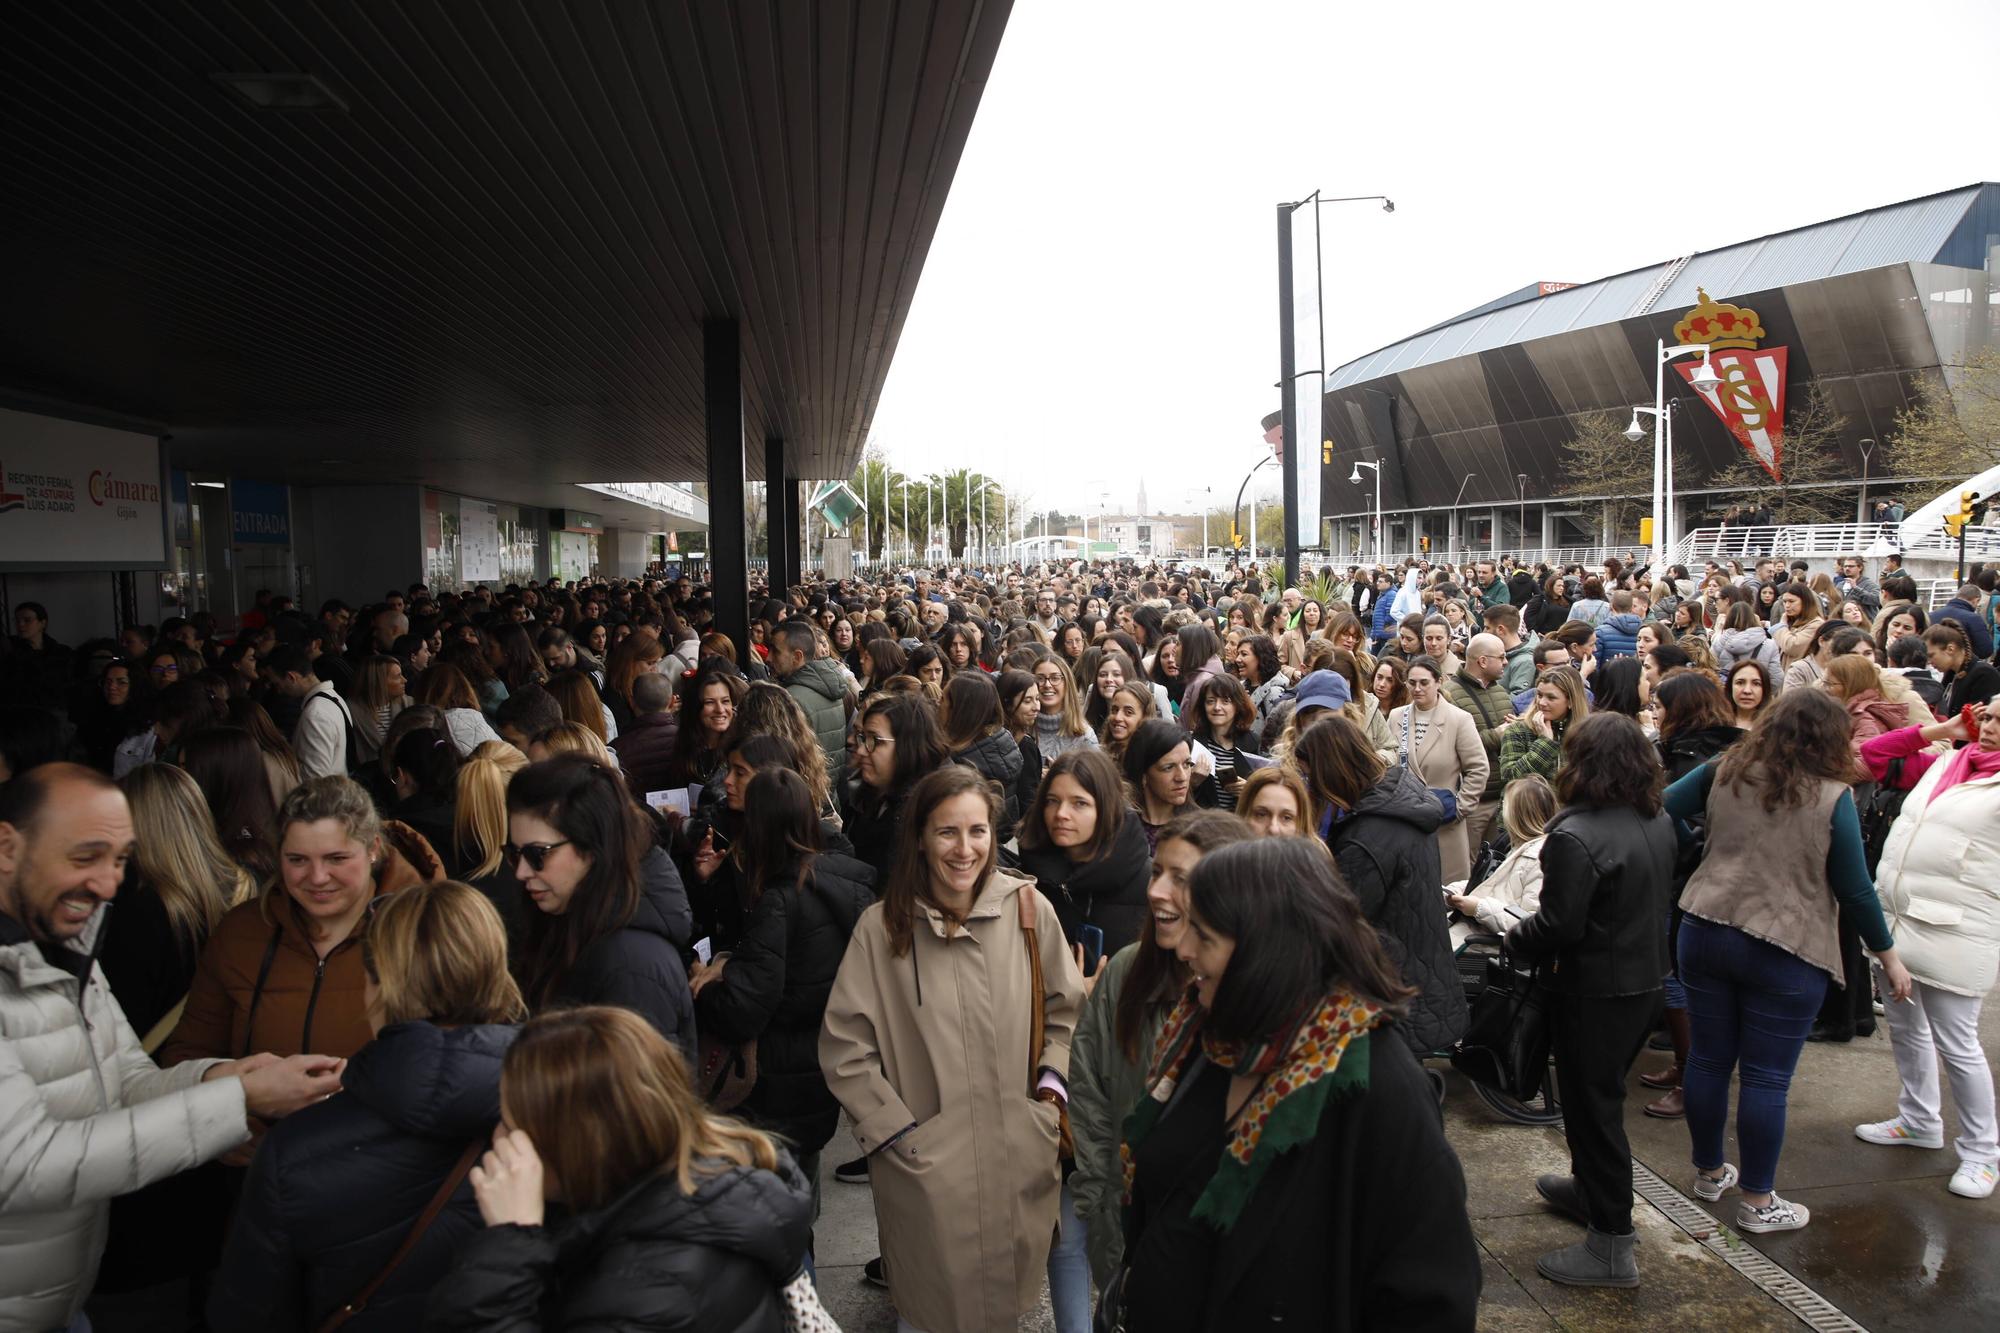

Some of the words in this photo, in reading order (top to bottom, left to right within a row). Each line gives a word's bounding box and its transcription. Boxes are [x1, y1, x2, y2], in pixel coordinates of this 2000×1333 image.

[7, 472, 45, 486] RECINTO
[46, 476, 74, 489] FERIAL
[88, 470, 159, 507] Cámara
[26, 487, 38, 498] DE
[39, 489, 75, 501] ASTURIAS
[27, 499, 46, 511] LUIS
[47, 501, 75, 513] ADARO
[117, 505, 137, 520] Gijón
[234, 511, 287, 535] ENTRADA
